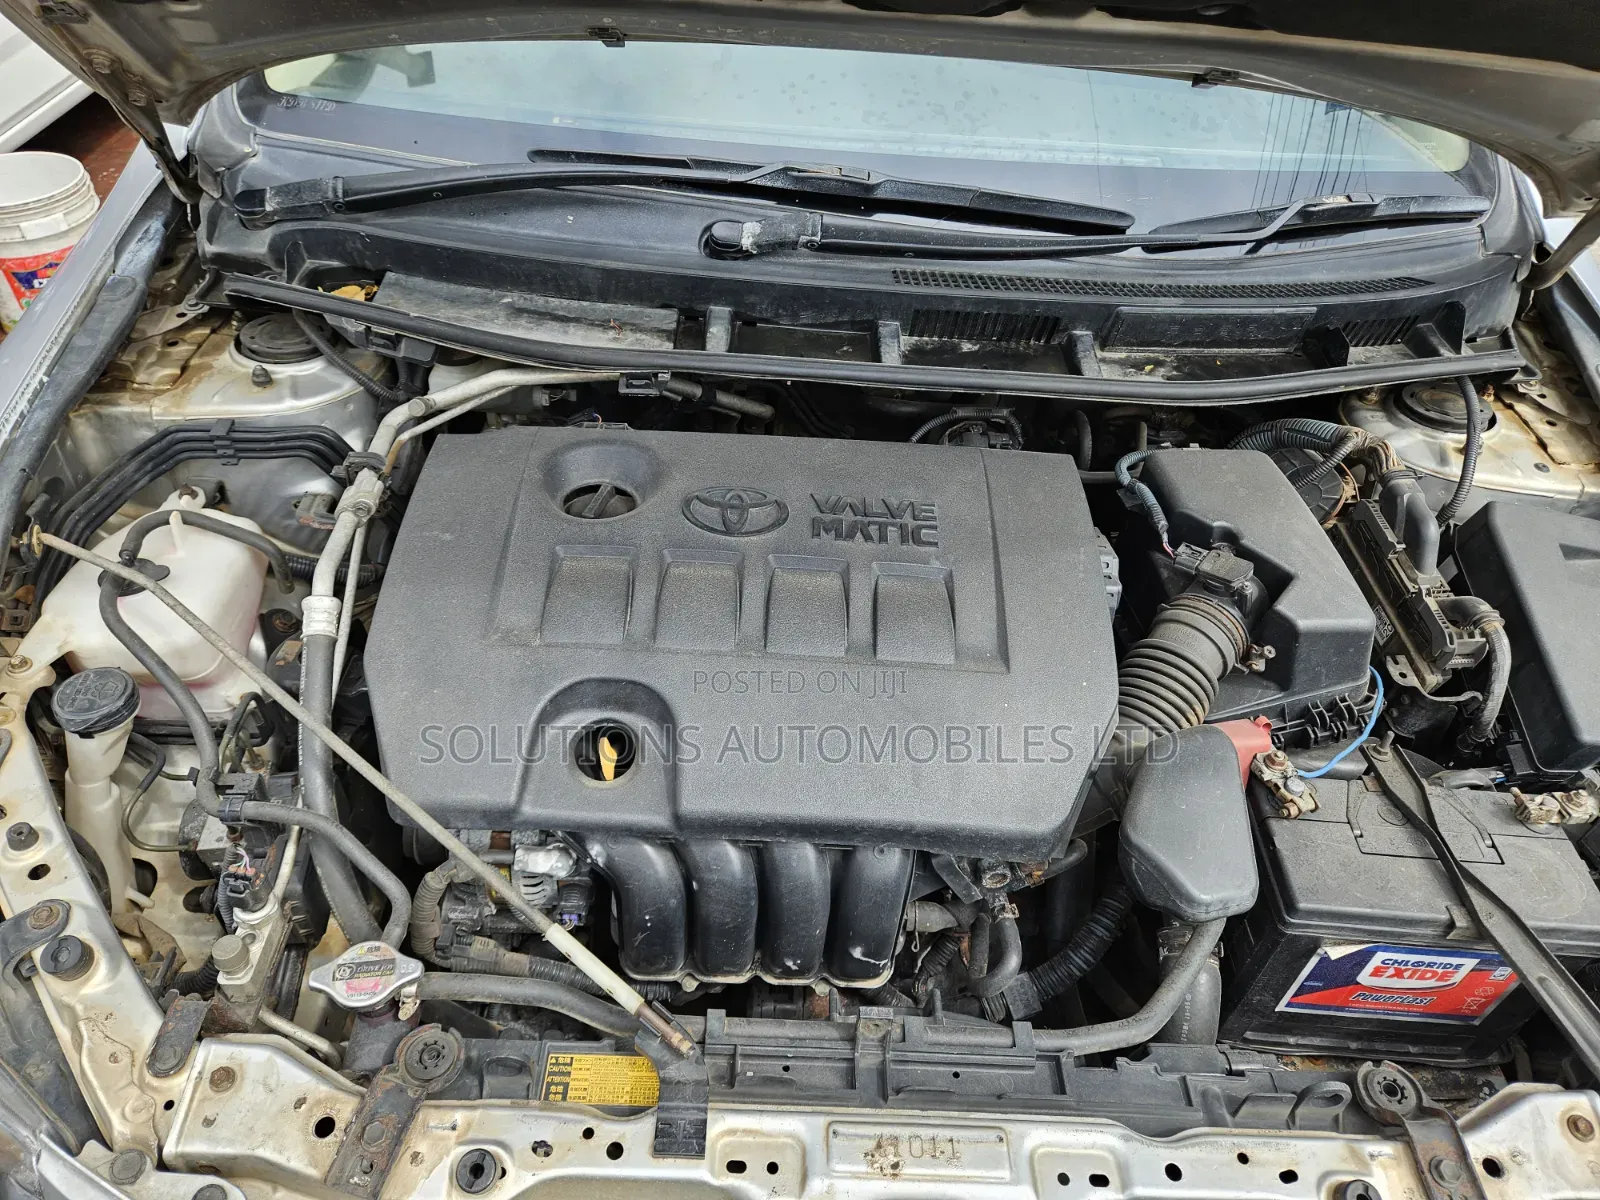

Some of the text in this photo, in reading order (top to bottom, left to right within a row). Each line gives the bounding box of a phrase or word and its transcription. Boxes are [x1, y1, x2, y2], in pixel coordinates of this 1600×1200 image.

[810, 493, 937, 521] VALVE
[811, 516, 939, 548] MATIC
[357, 964, 380, 973] DRIVE
[1380, 958, 1466, 971] CHLORIDE
[354, 971, 381, 979] RADIATOR
[1368, 965, 1459, 982] EXIDE
[546, 1075, 570, 1083] ATTENTION
